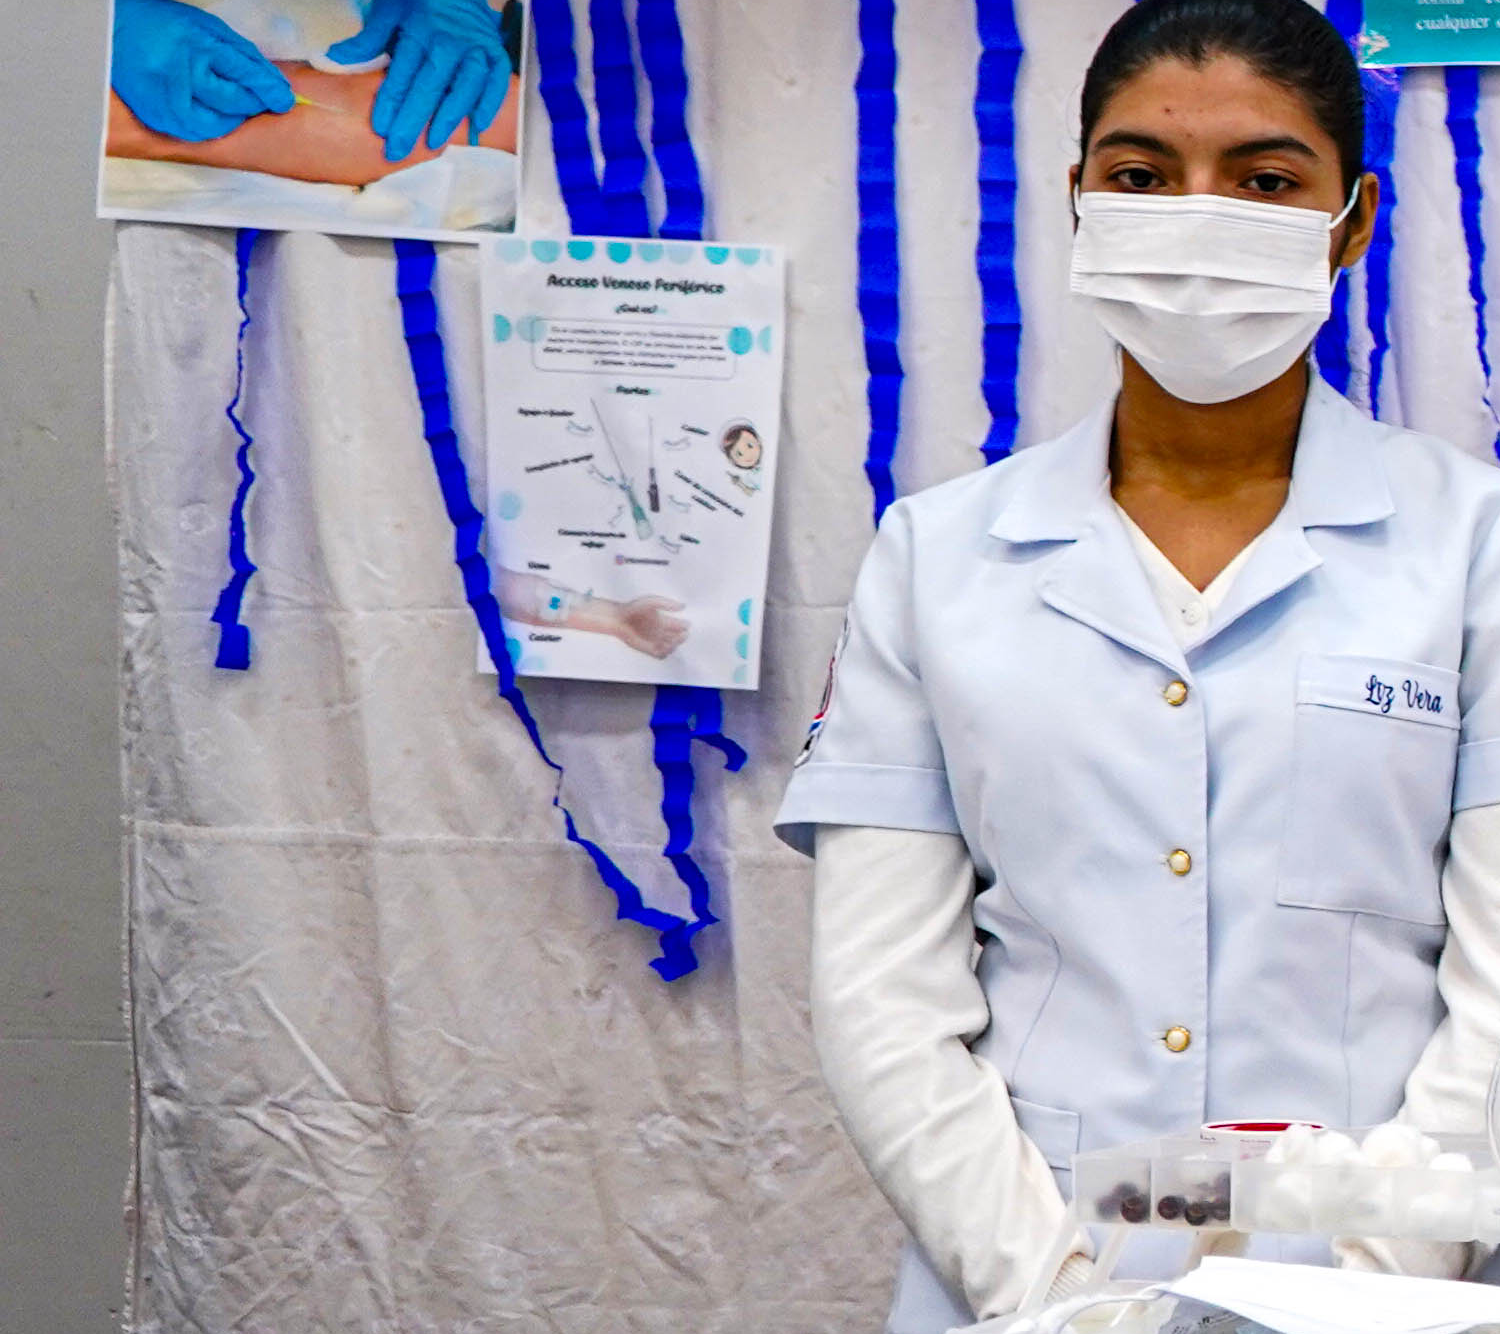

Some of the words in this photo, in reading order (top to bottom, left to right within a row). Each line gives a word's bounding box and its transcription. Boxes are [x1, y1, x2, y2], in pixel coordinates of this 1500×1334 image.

[1416, 14, 1490, 33] cualquier
[1365, 674, 1394, 714] Liz
[1402, 679, 1443, 714] Vera
